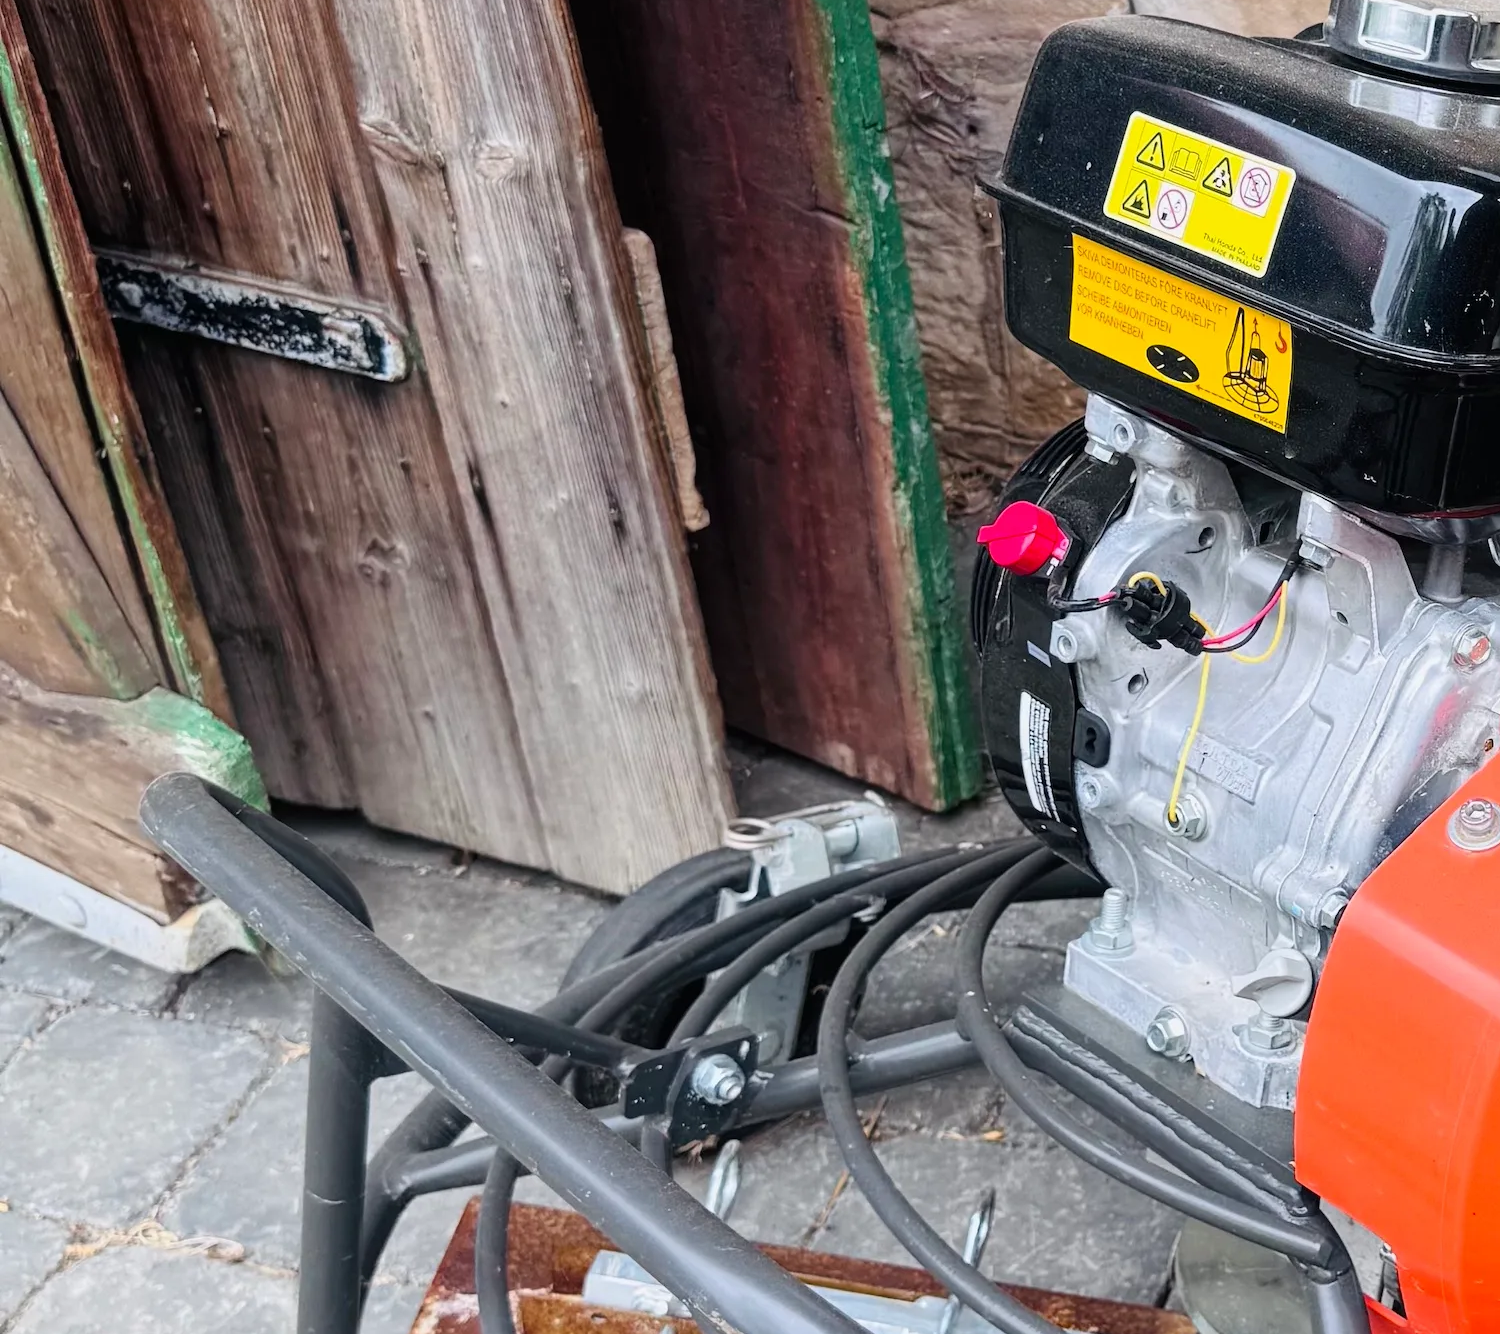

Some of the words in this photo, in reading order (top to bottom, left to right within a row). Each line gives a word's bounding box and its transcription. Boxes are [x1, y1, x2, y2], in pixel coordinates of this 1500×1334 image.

[1076, 245, 1101, 266] SKIVA
[1100, 252, 1158, 290] DEMONTERAS
[1159, 277, 1183, 299] FÖRE
[1184, 288, 1228, 318] KRANLYFT
[1076, 284, 1111, 308] SCHEIBE
[1111, 296, 1172, 334] ABMONTIEREN
[1077, 264, 1112, 289] REMOVE
[1113, 279, 1133, 297] DISC
[1134, 287, 1169, 313] BEFORE
[1170, 304, 1217, 332] CRANELIFT
[1076, 302, 1093, 317] VOR
[1094, 310, 1144, 340] KRANHEBEN
